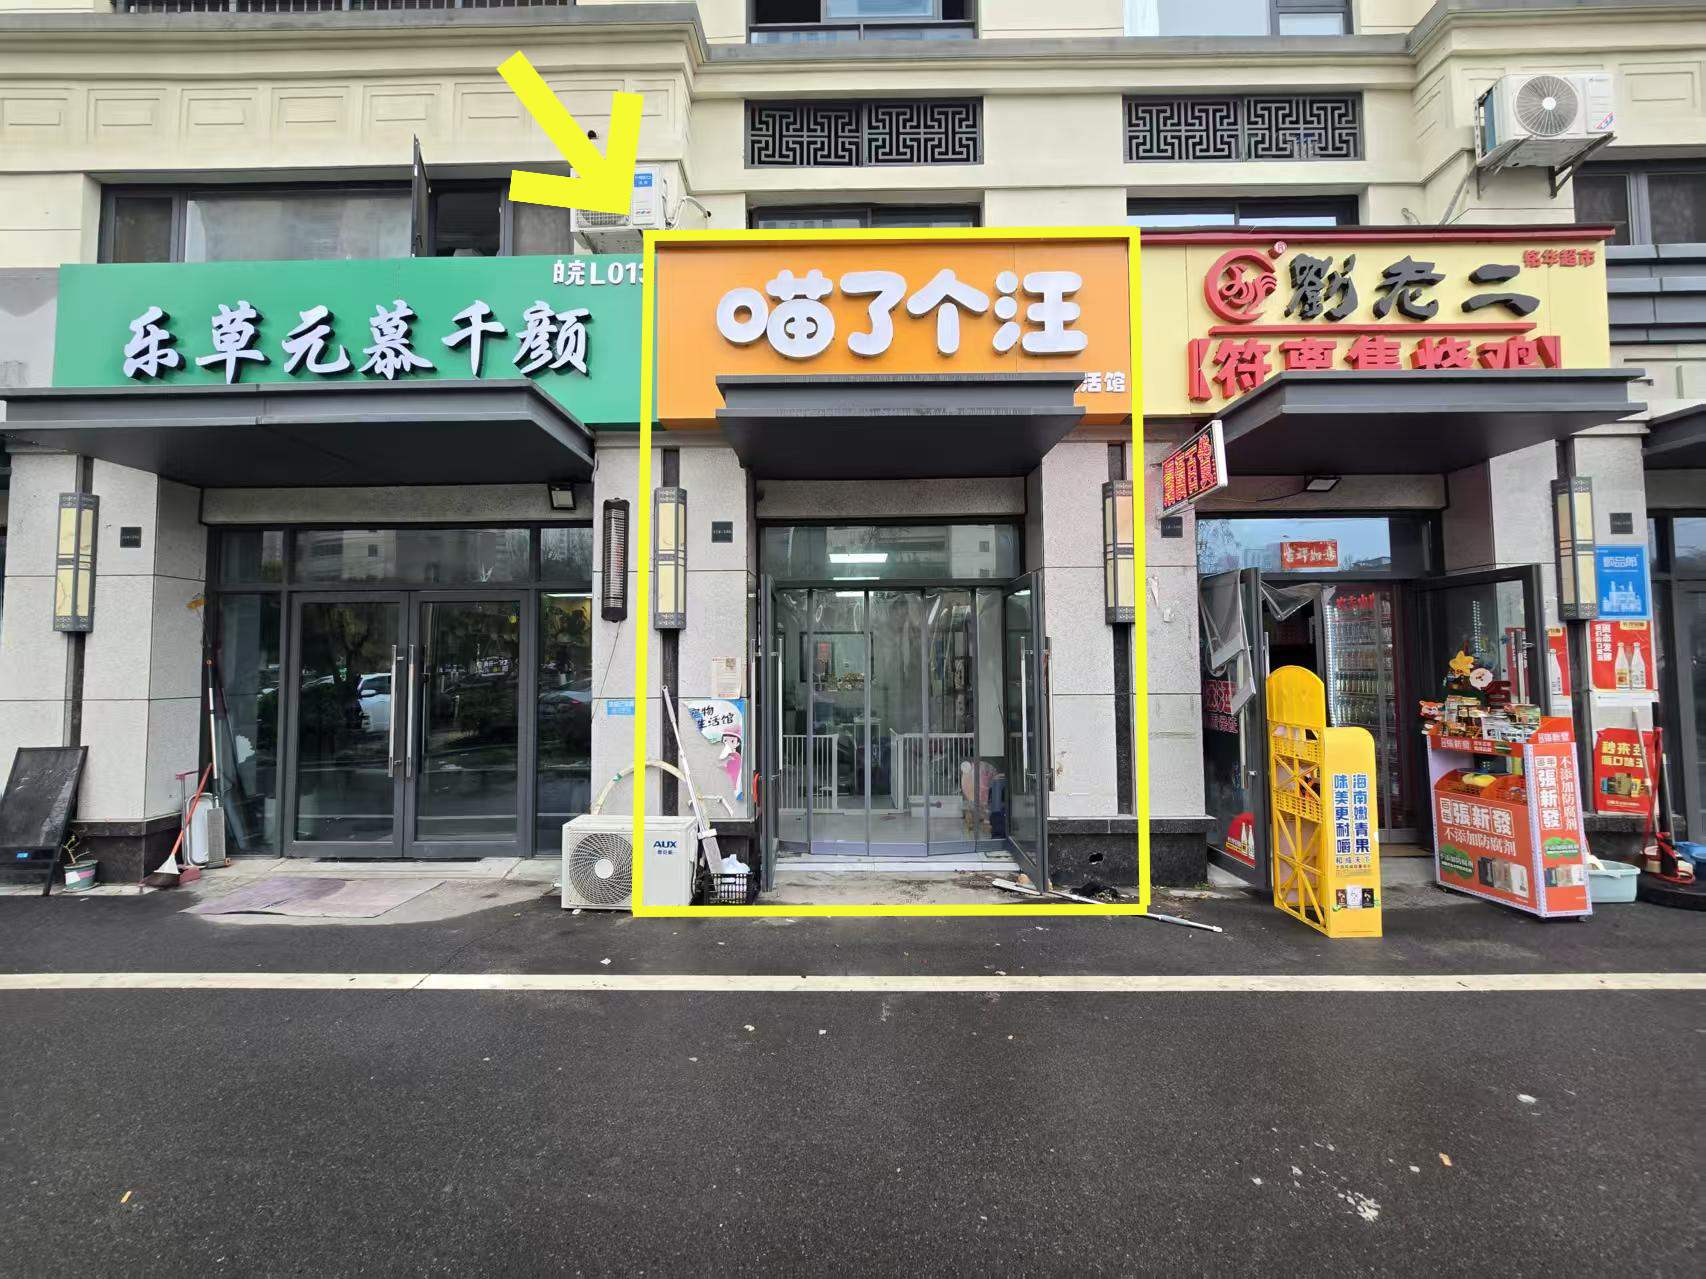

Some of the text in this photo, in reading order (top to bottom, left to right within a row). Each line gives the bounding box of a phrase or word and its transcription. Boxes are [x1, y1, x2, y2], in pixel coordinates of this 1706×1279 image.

[553, 259, 643, 286] 皖L01
[123, 300, 593, 384] 乐草元慕千颜
[716, 268, 1089, 360] 喵了个汪
[1074, 371, 1126, 393] 活馆
[653, 840, 677, 848] AUX
[1333, 774, 1351, 854] 味美更耐嚼
[1352, 774, 1370, 854] 海南嫩青果
